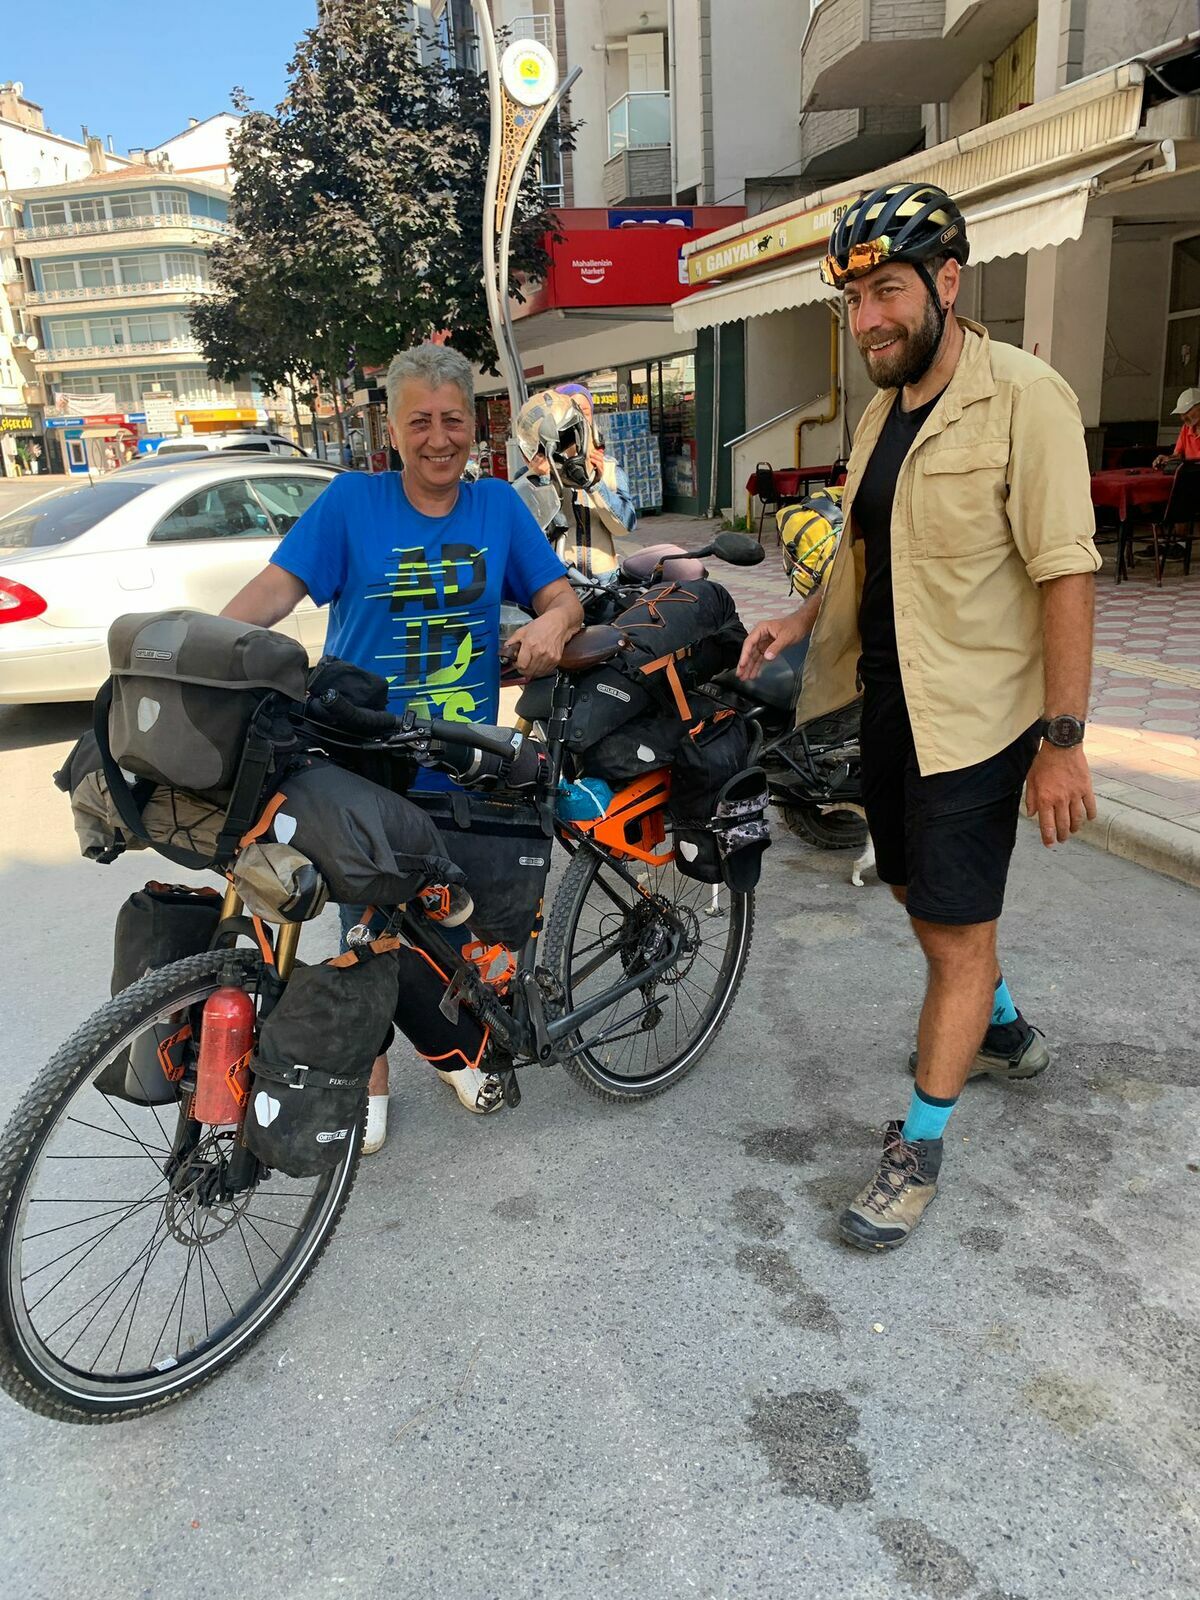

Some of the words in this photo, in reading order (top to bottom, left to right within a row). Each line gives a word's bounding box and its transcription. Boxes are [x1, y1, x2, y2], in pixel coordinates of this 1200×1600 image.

[706, 238, 759, 273] GANYAN
[571, 259, 613, 268] Mahallenizin
[580, 267, 605, 275] Marketi
